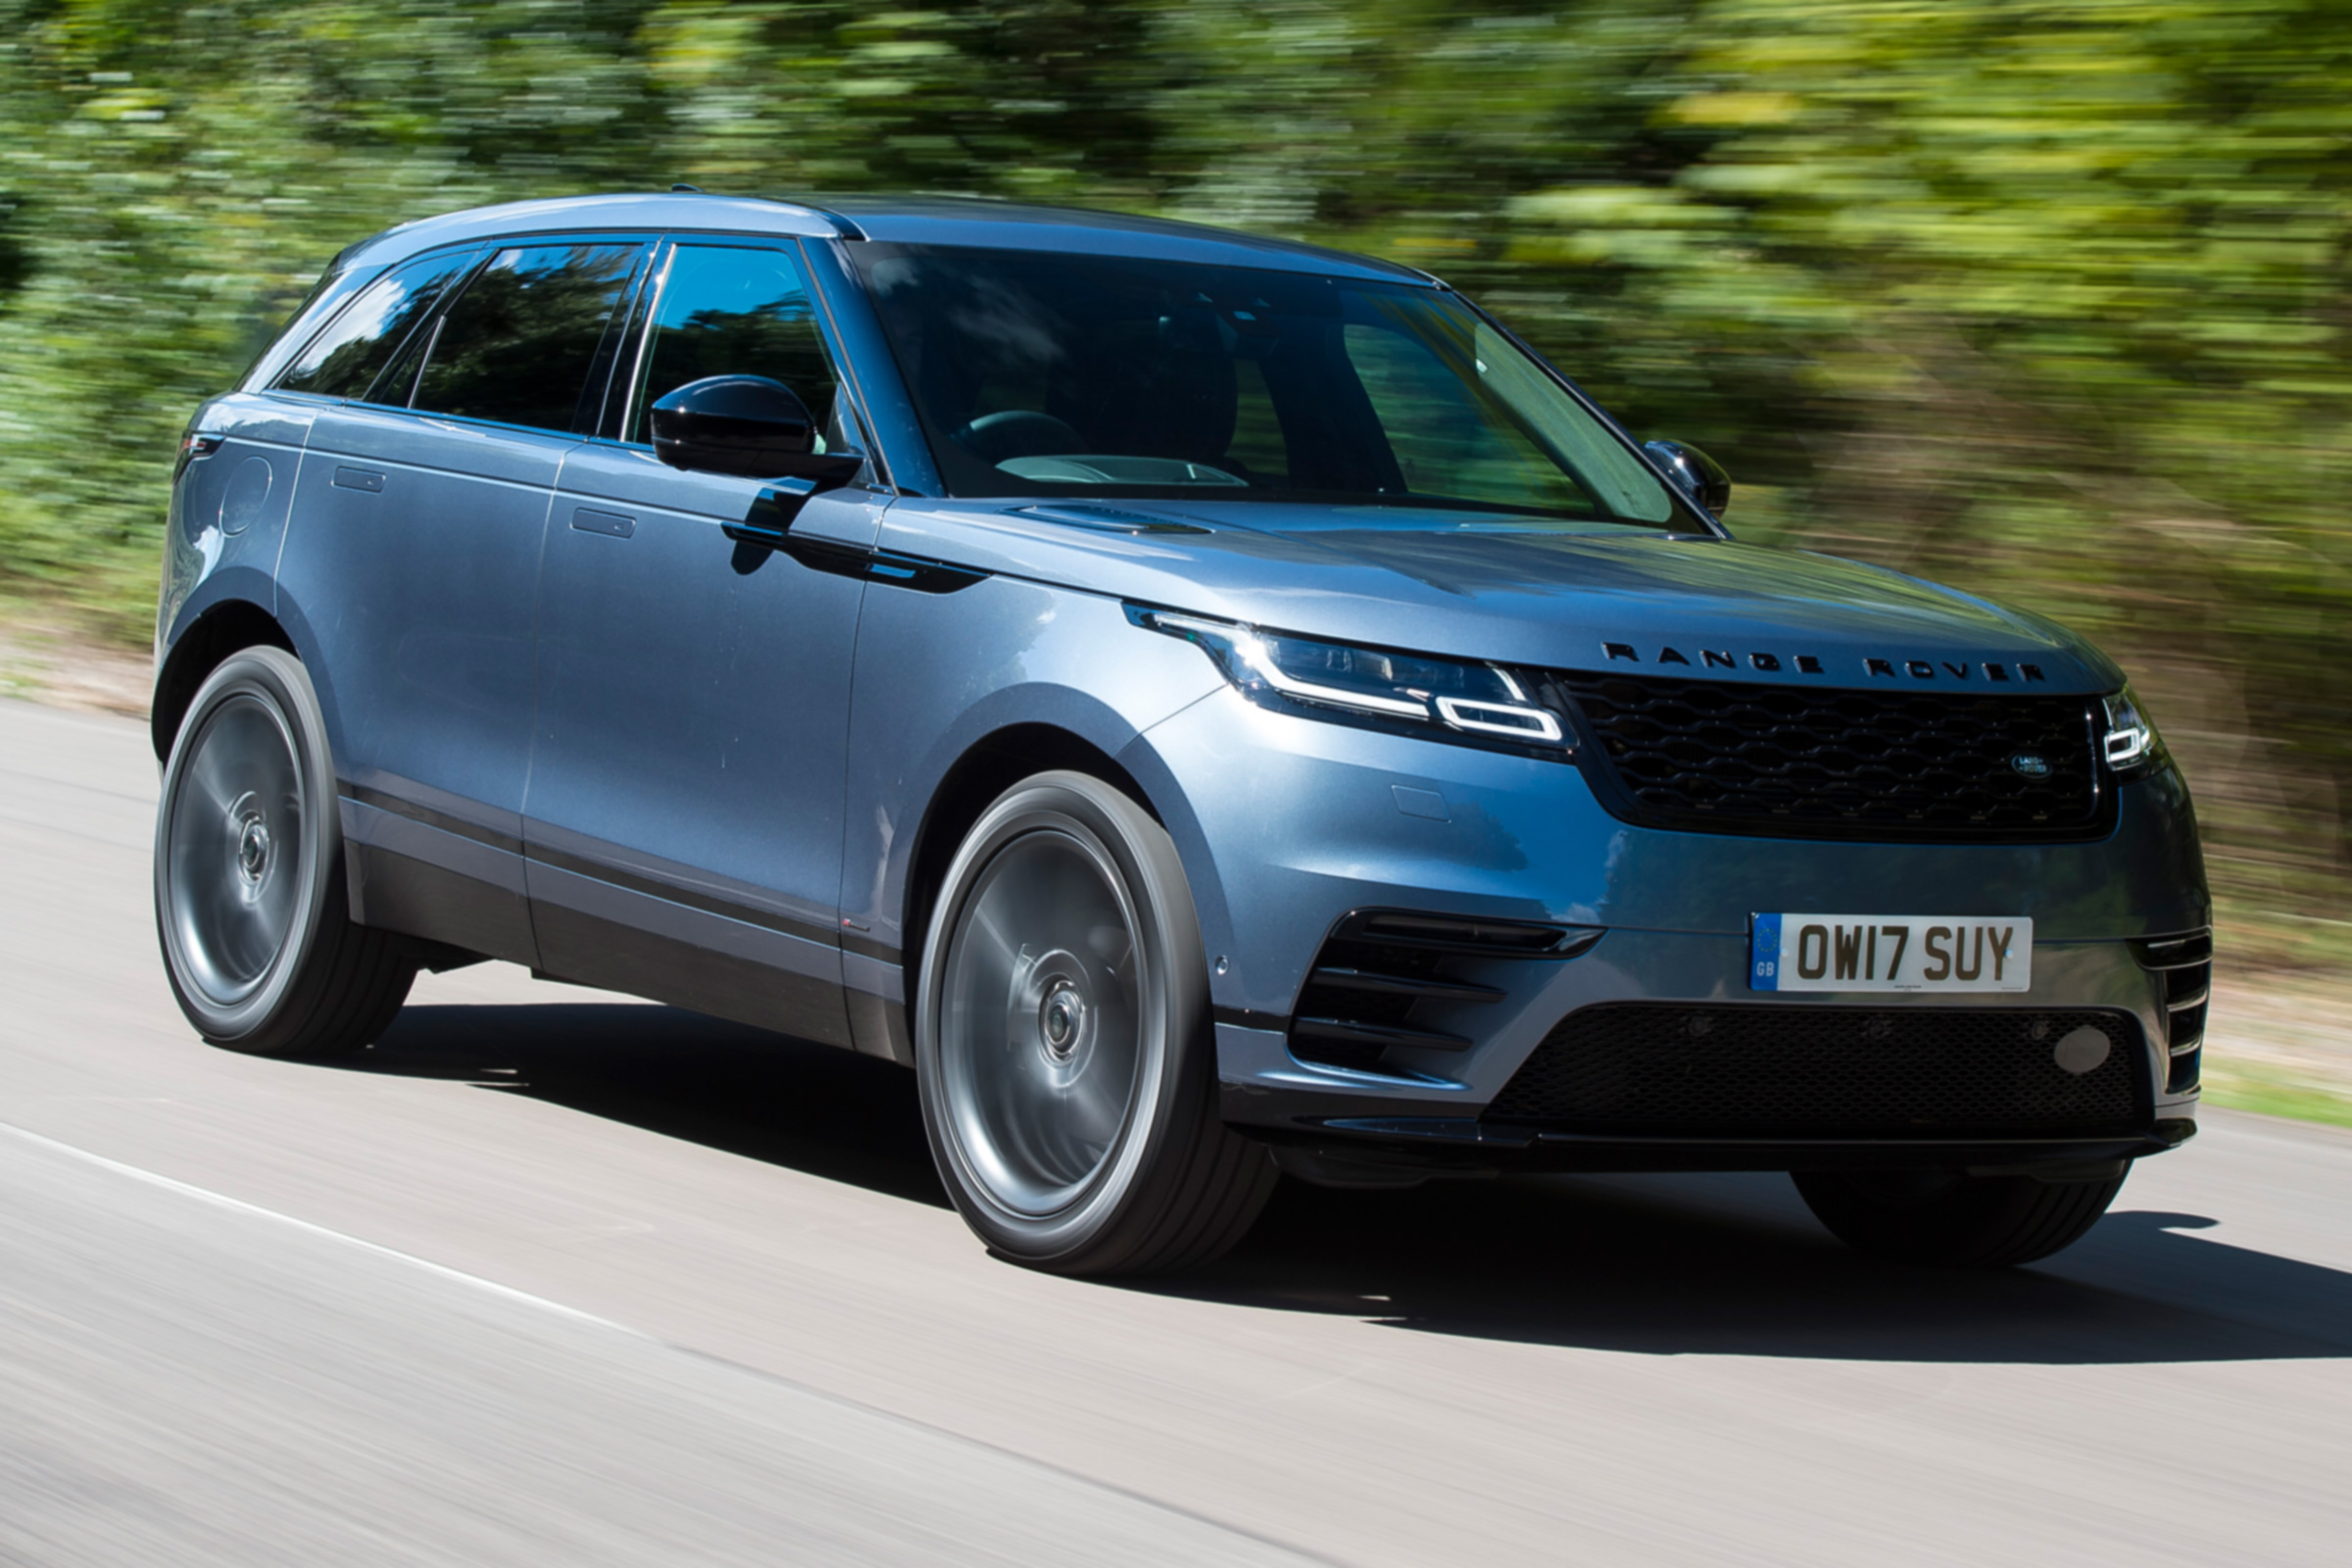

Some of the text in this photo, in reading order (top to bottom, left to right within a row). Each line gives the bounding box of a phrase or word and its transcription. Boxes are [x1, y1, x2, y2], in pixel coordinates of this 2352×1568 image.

[1600, 641, 2045, 682] RANGE ROVER
[1757, 961, 1775, 977] GB
[1797, 924, 2014, 982] OW17 SUY
